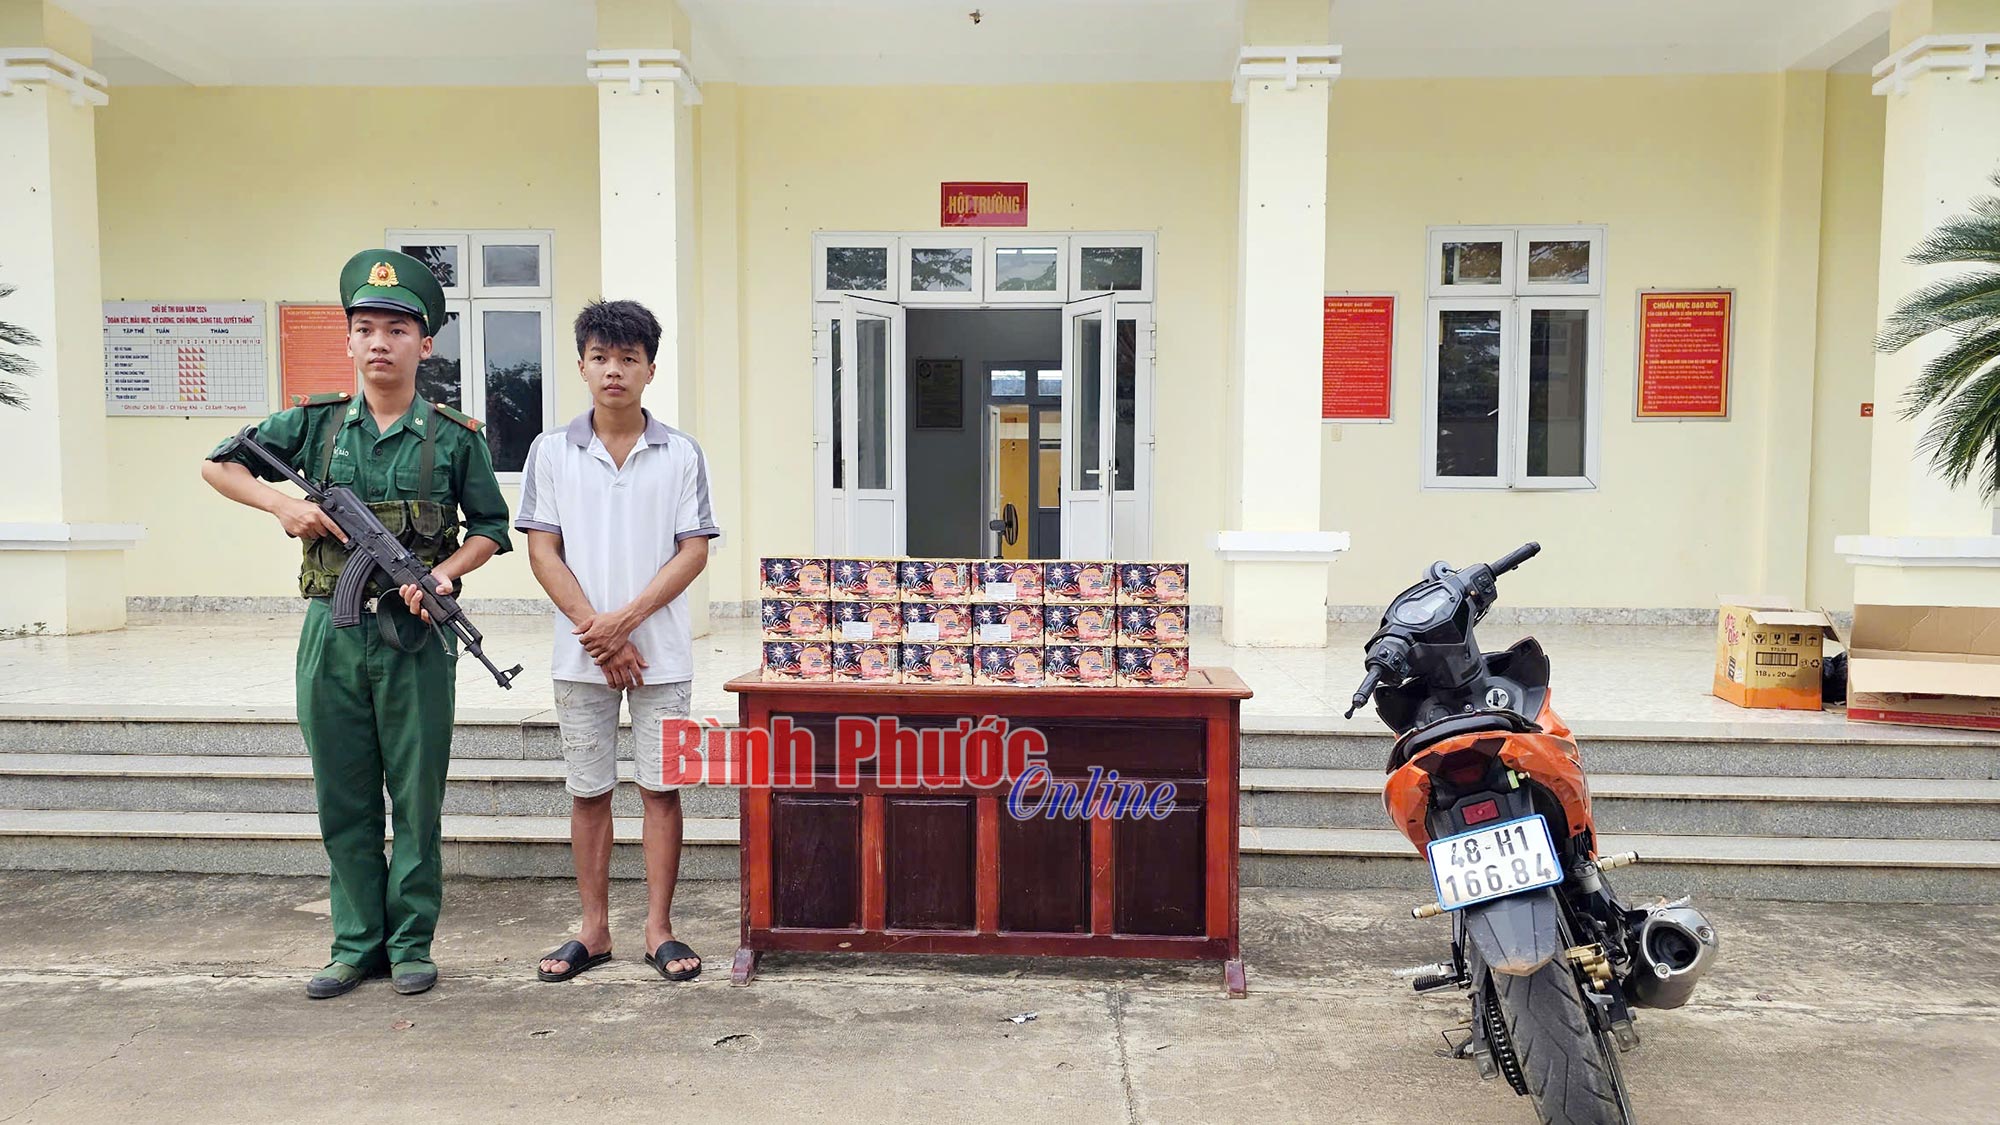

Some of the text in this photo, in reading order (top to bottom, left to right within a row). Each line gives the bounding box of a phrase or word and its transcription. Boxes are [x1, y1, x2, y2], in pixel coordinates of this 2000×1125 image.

[949, 191, 1020, 217] HỘI TRƯỜNG
[1676, 301, 1690, 310] MỰC
[1451, 826, 1529, 868] 48-H1
[1446, 853, 1552, 902] 166.84
